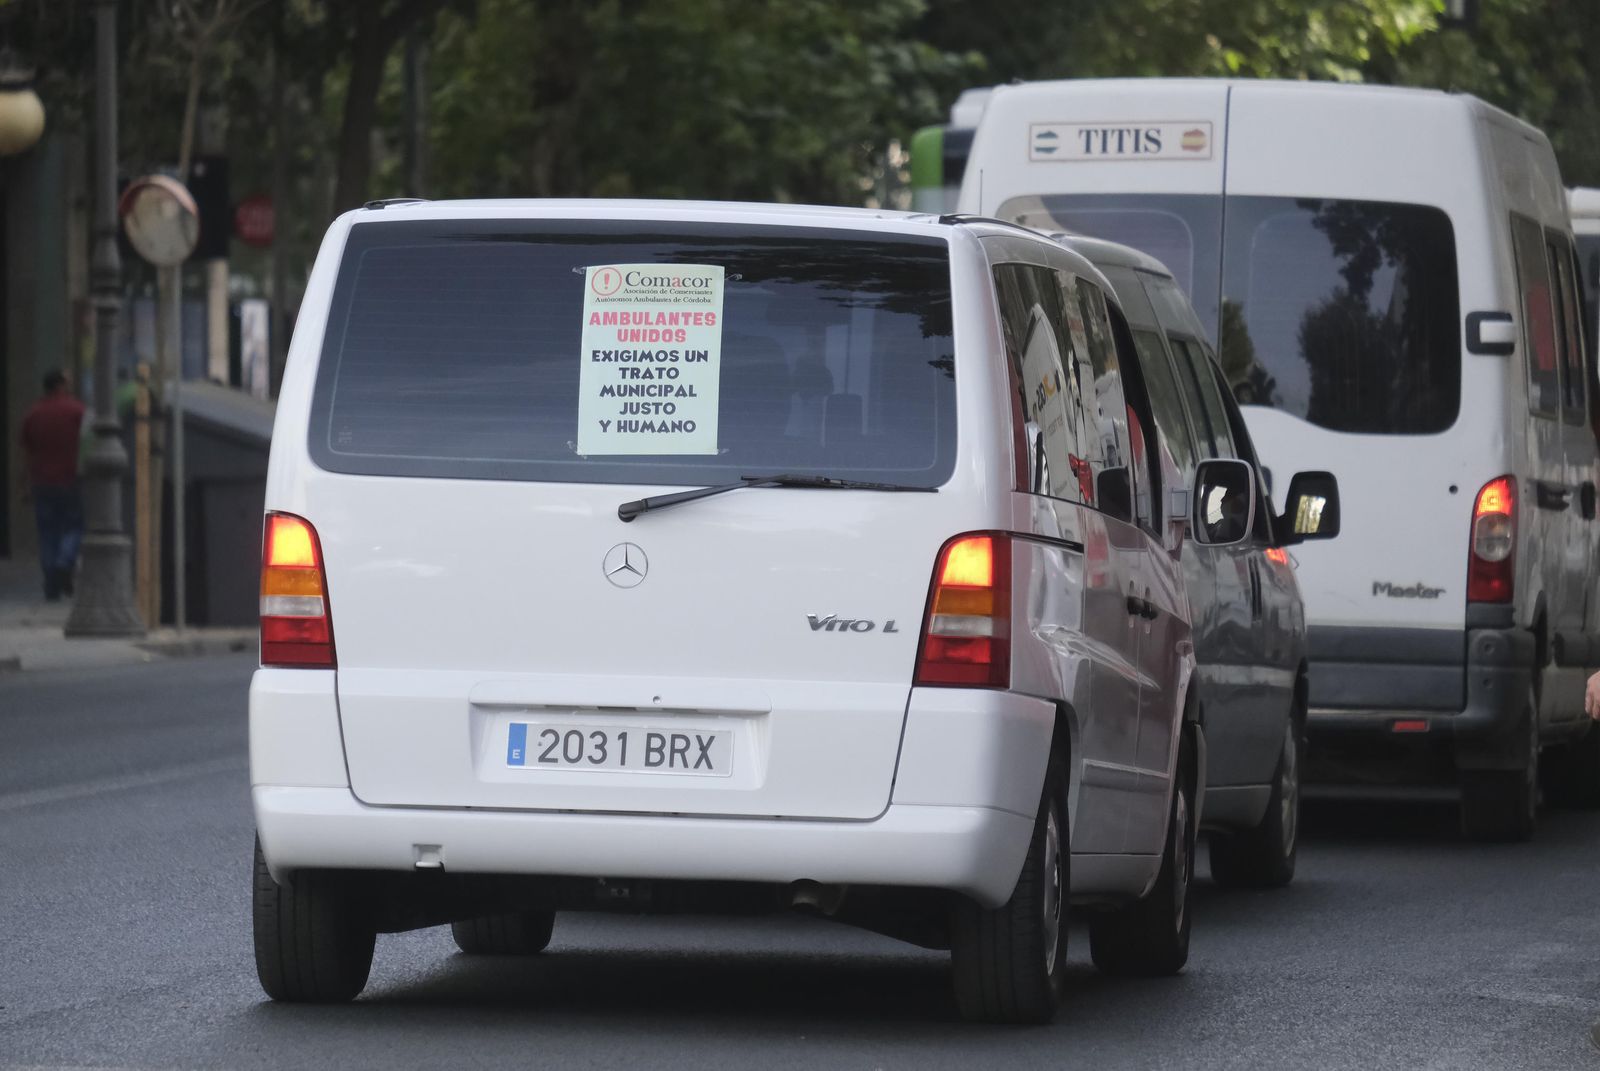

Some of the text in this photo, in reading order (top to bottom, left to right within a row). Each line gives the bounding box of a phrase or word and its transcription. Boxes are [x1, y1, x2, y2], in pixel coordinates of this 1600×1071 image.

[1078, 128, 1162, 154] TITIS
[625, 271, 713, 288] Comacor
[669, 288, 713, 296] Comerciantes
[683, 296, 712, 304] Córdoba
[589, 311, 717, 326] AMBULANTES
[617, 328, 687, 343] UNIDOS
[592, 349, 709, 363] EXIGIMOS UN
[618, 367, 680, 380] TRATO
[599, 384, 698, 398] MUNICIPAL
[619, 402, 677, 415] JUSTO
[598, 419, 697, 434] Y HUMANO
[882, 620, 899, 633] L
[511, 728, 716, 770] E 2031 BRX
